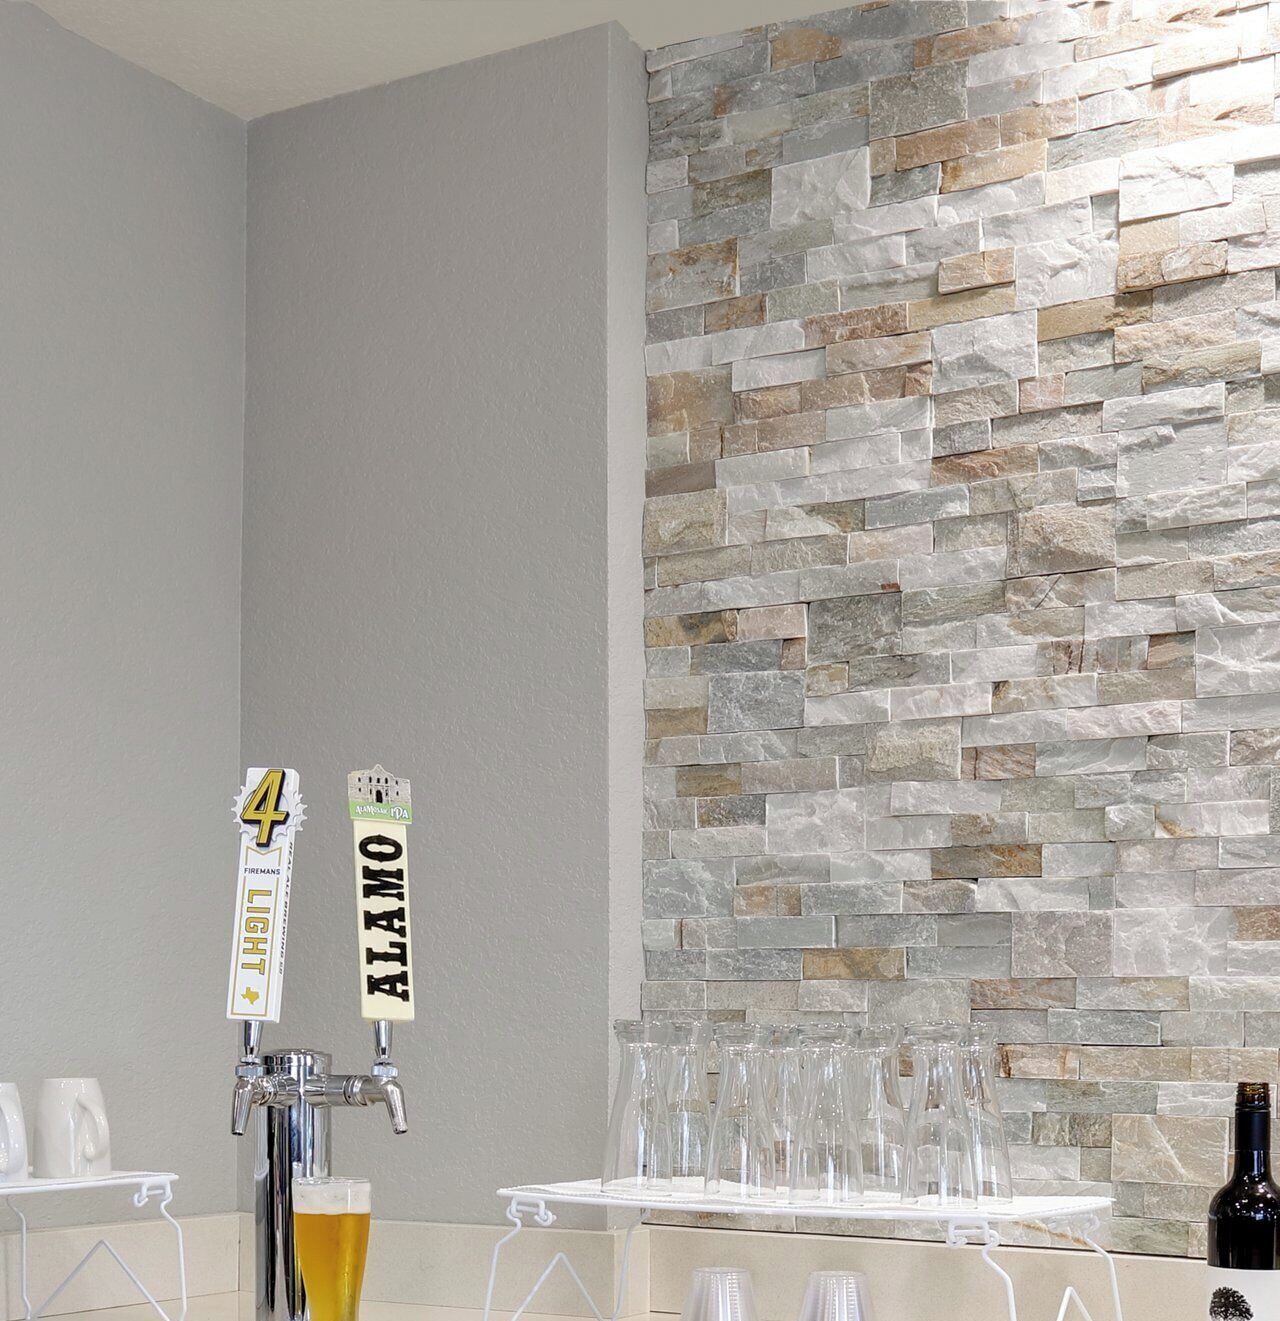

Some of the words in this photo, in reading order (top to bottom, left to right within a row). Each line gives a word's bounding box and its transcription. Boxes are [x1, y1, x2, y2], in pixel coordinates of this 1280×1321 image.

[240, 769, 289, 847] 4
[390, 806, 409, 819] IPA
[244, 868, 281, 876] FIREMANS
[241, 889, 272, 976] LIGHT
[358, 834, 410, 1002] ALAMO
